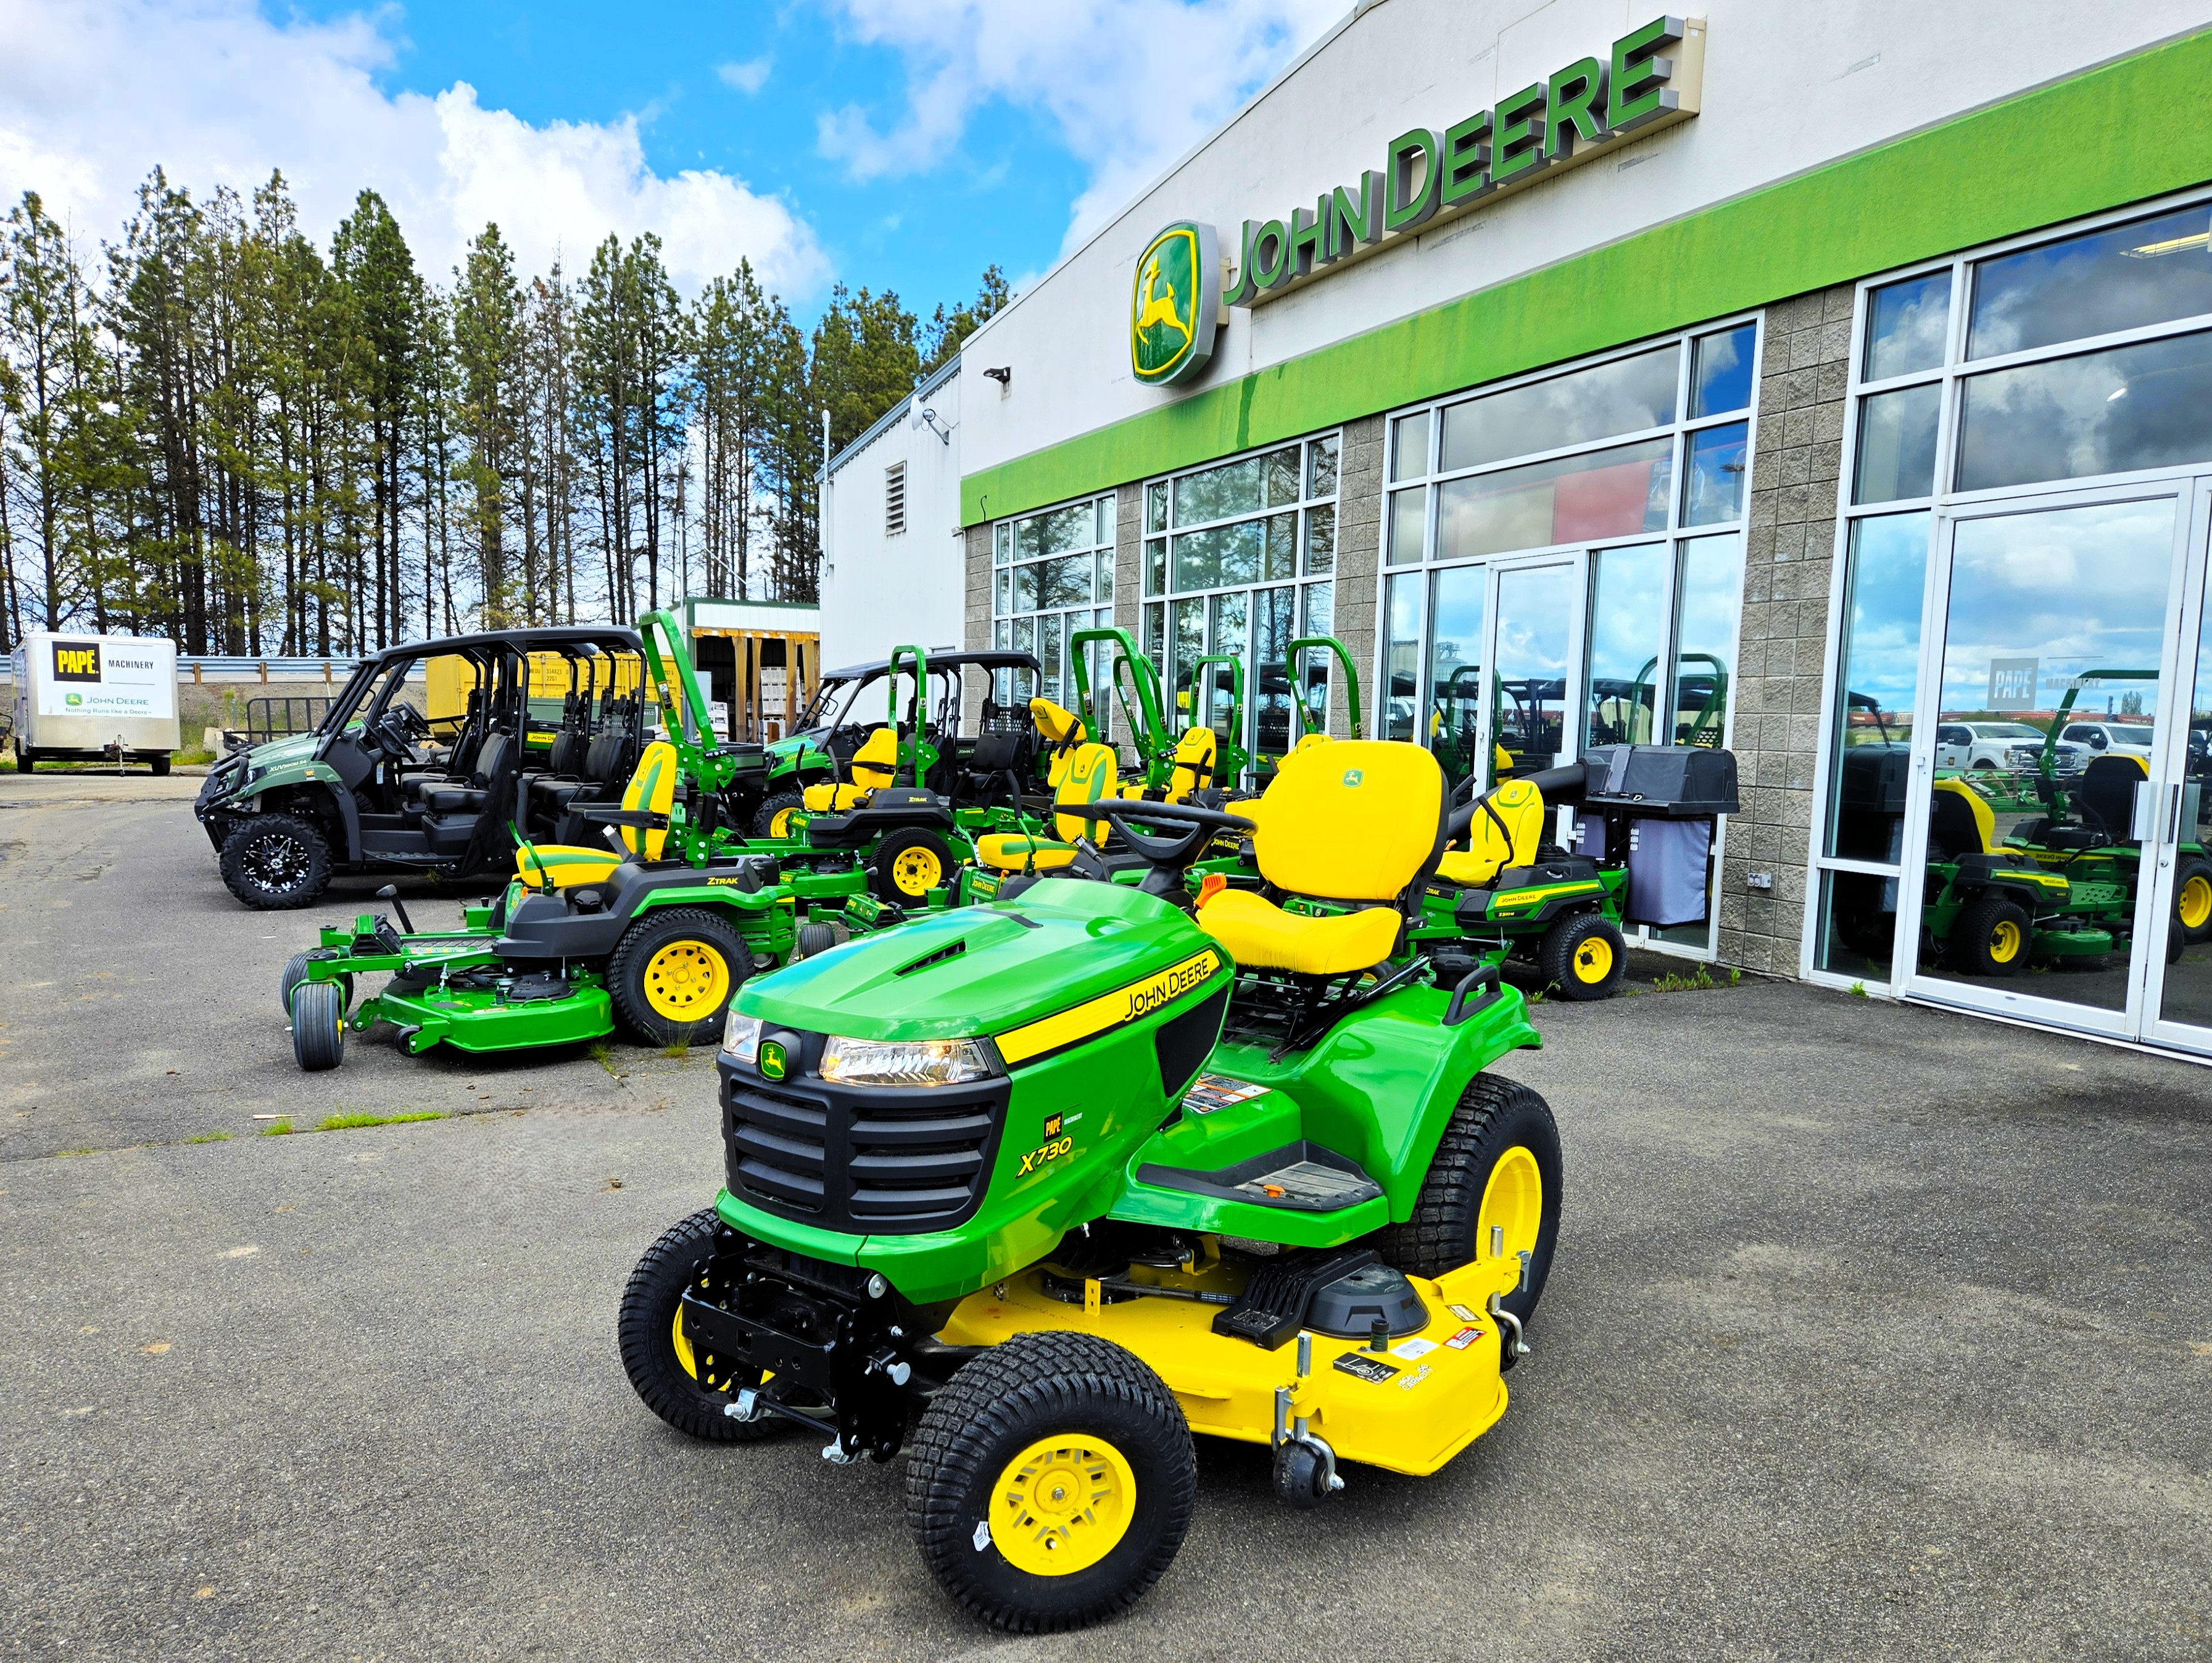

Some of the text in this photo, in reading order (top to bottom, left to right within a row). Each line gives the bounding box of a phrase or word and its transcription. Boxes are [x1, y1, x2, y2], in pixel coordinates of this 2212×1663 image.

[1223, 15, 1683, 307] JOHN DEERE
[109, 660, 154, 670] MACHINERY
[1994, 667, 2032, 699] PAPÉ
[2045, 678, 2101, 690] MACHINERY
[117, 697, 149, 705] DEERE
[1213, 837, 1240, 850] JOHN DEERE
[707, 877, 739, 885] ZTRAK
[972, 878, 995, 893] JOHN DEERE
[1125, 958, 1209, 1019] JOHN DEERE
[1016, 1135, 1074, 1178] X730
[1397, 1374, 1415, 1387] HIGH
[1401, 1366, 1433, 1391] CAPACITY
